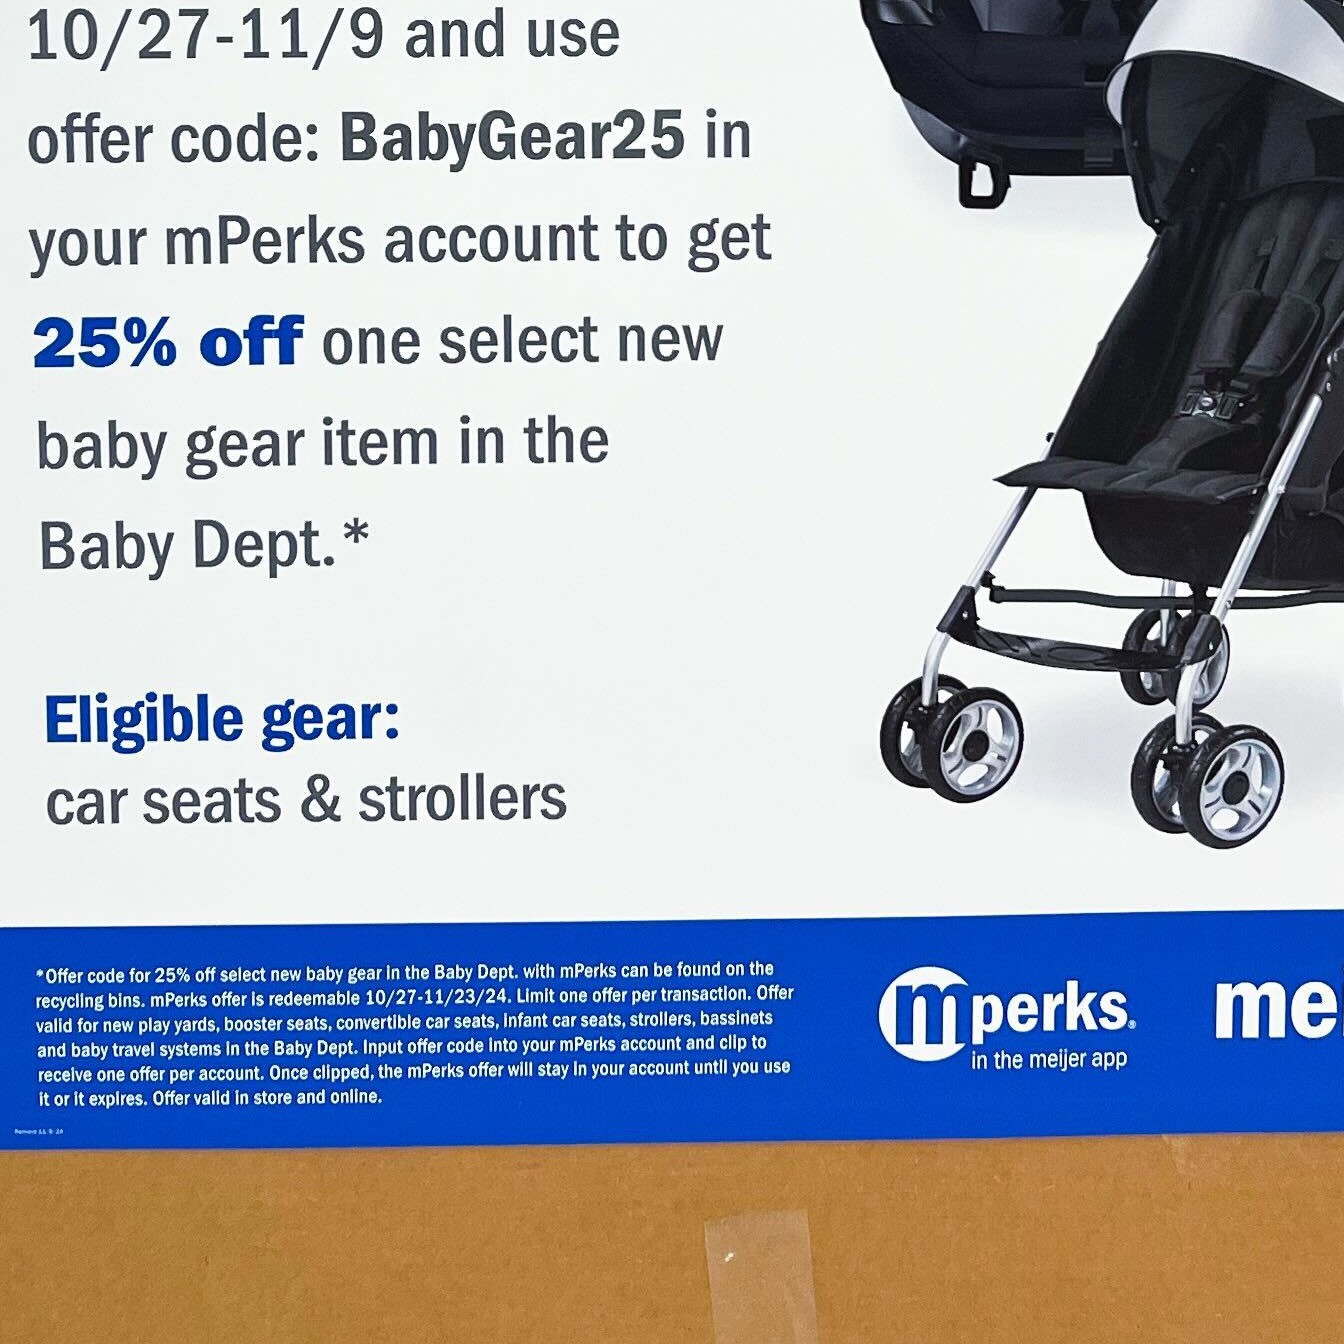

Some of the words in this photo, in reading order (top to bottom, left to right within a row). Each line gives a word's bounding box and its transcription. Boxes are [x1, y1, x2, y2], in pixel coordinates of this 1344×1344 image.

[29, 6, 383, 72] 10/27-11/9
[405, 6, 504, 59] and
[527, 18, 620, 58] use
[28, 111, 154, 165] offer
[171, 111, 318, 163] code:
[341, 108, 685, 173] BabyGear25
[705, 107, 750, 159] in
[28, 227, 148, 279] your
[166, 213, 365, 265] mPerks
[384, 214, 600, 264] account
[615, 214, 668, 262] to
[687, 213, 773, 273] get
[33, 315, 177, 369] 25%
[199, 313, 305, 367] off
[323, 326, 421, 366] one
[439, 314, 600, 364] select
[619, 324, 724, 362] new
[37, 419, 168, 481] baby
[185, 424, 306, 481] gear
[322, 416, 438, 466] item
[459, 414, 504, 464] in
[522, 414, 609, 464] the
[41, 520, 175, 581] Baby
[45, 691, 244, 755] Eligible
[261, 698, 399, 753] gear:
[46, 787, 129, 826] car
[143, 777, 282, 825] seats
[300, 773, 342, 823] &
[358, 772, 567, 822] strollers
[35, 992, 105, 1012] recycling
[108, 992, 146, 1009] bins.
[150, 991, 208, 1008] mPerks
[211, 990, 248, 1008] offer
[251, 990, 265, 1007] is
[268, 990, 361, 1007] redeemable
[366, 987, 512, 1009] 10/27-11/23/24.
[516, 987, 556, 1004] Limit
[559, 990, 588, 1004] one
[592, 986, 628, 1003] offer
[631, 989, 658, 1006] per
[660, 985, 752, 1002] transaction.
[756, 984, 795, 1001] Offer
[87, 967, 125, 984] code
[128, 967, 152, 984] for
[154, 967, 191, 984] 25%
[194, 966, 217, 983] off
[219, 966, 267, 983] select
[270, 969, 302, 982] new
[306, 965, 344, 985] baby
[347, 967, 383, 985] gear
[386, 964, 400, 981] in
[404, 964, 430, 981] the
[434, 963, 474, 983] Baby
[477, 963, 519, 983] Dept.
[522, 962, 555, 979] with
[560, 962, 617, 979] mPerks
[620, 965, 649, 978] can
[653, 961, 673, 978] be
[676, 960, 721, 977] found
[725, 963, 745, 977] on
[748, 960, 774, 976] the
[35, 1017, 73, 1034] valid
[76, 1017, 100, 1033] for
[103, 1020, 134, 1033] new
[138, 1016, 171, 1036] play
[173, 1016, 221, 1036] yards,
[224, 1016, 283, 1032] booster
[286, 1016, 333, 1033] seats,
[336, 1013, 422, 1031] convertible
[425, 1016, 451, 1030] car
[453, 1013, 500, 1030] seats,
[503, 1011, 549, 1028] infant
[552, 1015, 577, 1028] car
[580, 1012, 626, 1029] seats,
[629, 1010, 696, 1028] strollers,
[700, 1009, 774, 1026] bassinets
[37, 1042, 67, 1059] and
[71, 1041, 109, 1061] baby
[111, 1041, 155, 1058] travel
[159, 1041, 222, 1060] systems
[225, 1040, 240, 1057] in
[244, 1040, 270, 1057] the
[274, 1039, 313, 1059] Baby
[317, 1039, 359, 1059] Dept.
[363, 1039, 404, 1058] Input
[407, 1037, 444, 1055] offer
[446, 1037, 484, 1054] code
[488, 1036, 518, 1053] into
[522, 1039, 556, 1056] your
[559, 1035, 617, 1052] mPerks
[620, 1035, 682, 1052] account
[685, 1034, 715, 1051] and
[719, 1033, 747, 1053] clip
[751, 1034, 767, 1050] to
[38, 1066, 93, 1083] receive
[96, 1069, 126, 1082] one
[129, 1065, 166, 1082] offer
[169, 1068, 196, 1085] per
[198, 1065, 265, 1082] account.
[269, 1064, 309, 1081] Once
[312, 1063, 375, 1083] clipped,
[377, 1063, 403, 1080] the
[407, 1062, 465, 1079] mPerks
[468, 1061, 505, 1078] offer
[507, 1060, 533, 1077] will
[537, 1061, 570, 1080] stay
[573, 1060, 587, 1077] in
[591, 1063, 625, 1080] your
[628, 1060, 690, 1076] account
[694, 1058, 728, 1075] until
[732, 1061, 759, 1078] you
[763, 1060, 791, 1074] use
[971, 1050, 988, 1070] in
[993, 1049, 1024, 1070] the
[1029, 1048, 1087, 1072] meijer
[1091, 1051, 1128, 1071] app
[39, 1091, 50, 1107] it
[53, 1094, 71, 1107] or
[73, 1090, 85, 1107] it
[88, 1090, 148, 1110] expires.
[152, 1089, 191, 1106] Offer
[193, 1089, 230, 1106] valid
[234, 1089, 249, 1106] in
[253, 1090, 293, 1105] store
[296, 1088, 326, 1105] and
[330, 1087, 383, 1105] online.
